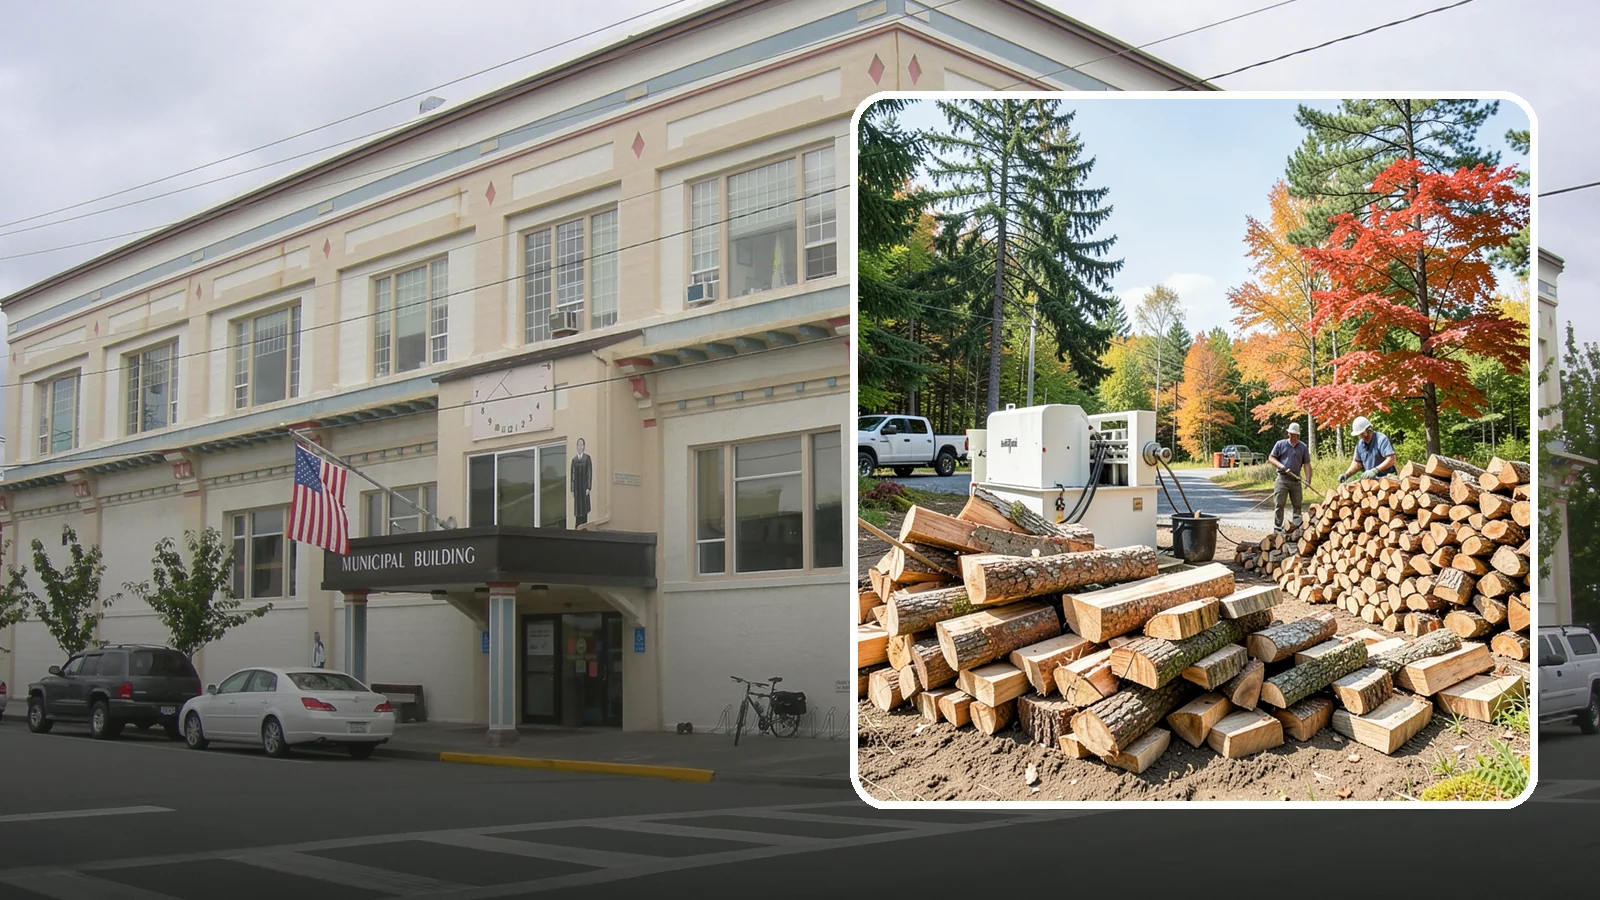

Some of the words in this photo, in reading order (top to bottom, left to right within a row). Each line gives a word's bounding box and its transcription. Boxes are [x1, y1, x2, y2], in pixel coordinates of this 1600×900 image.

[475, 390, 479, 398] 7
[481, 407, 485, 415] 8
[494, 423, 500, 431] 10
[507, 425, 513, 433] 12
[521, 420, 525, 428] 2
[529, 414, 533, 422] 3
[536, 402, 540, 410] 4
[342, 552, 405, 571] MUNICIPAL
[414, 546, 475, 567] BUILDING
